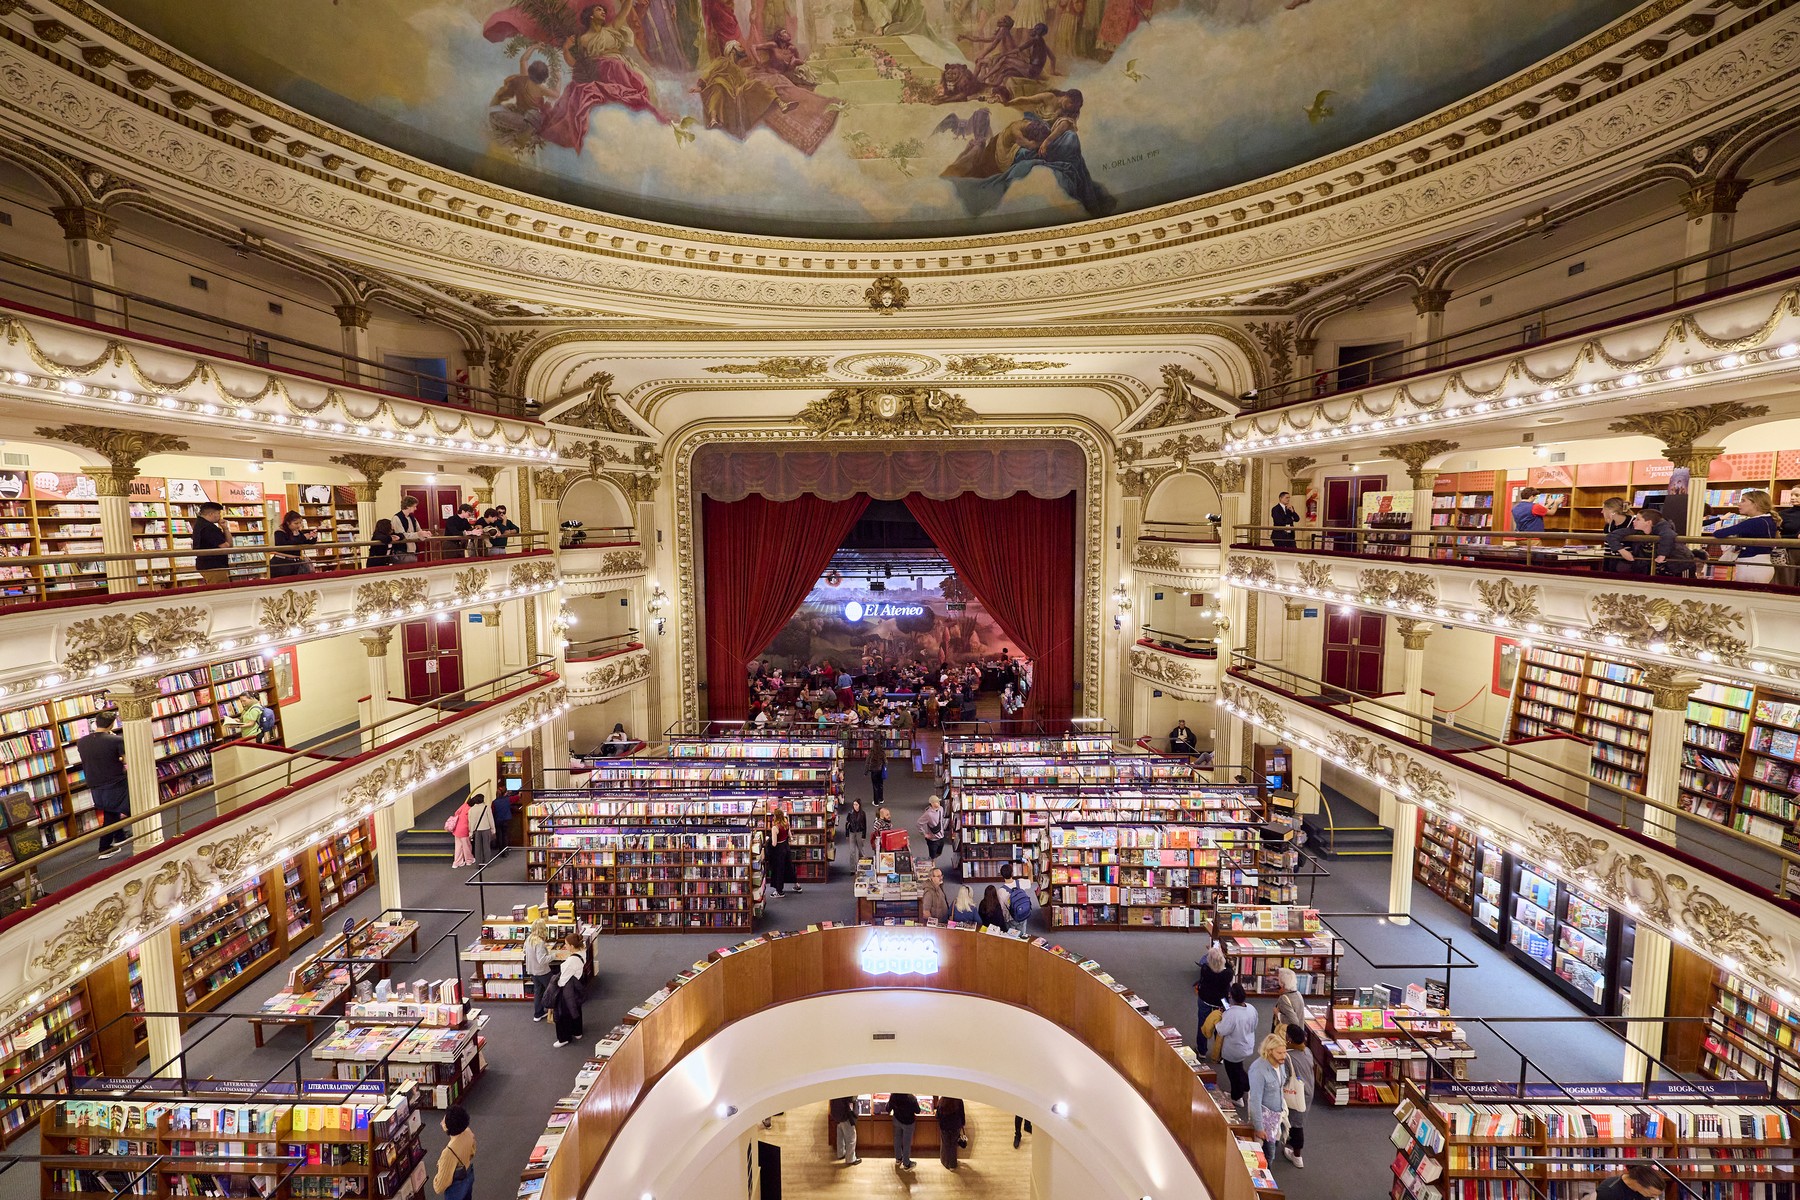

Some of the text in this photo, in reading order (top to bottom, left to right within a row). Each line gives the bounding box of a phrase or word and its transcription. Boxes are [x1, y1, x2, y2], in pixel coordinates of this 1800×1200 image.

[1111, 154, 1143, 169] ORLANDI
[1645, 464, 1675, 475] LITERATU
[129, 483, 151, 496] ANGA
[230, 489, 255, 497] MANGA
[864, 603, 924, 616] El Ateneo
[337, 1083, 380, 1091] LATINOMERICANA
